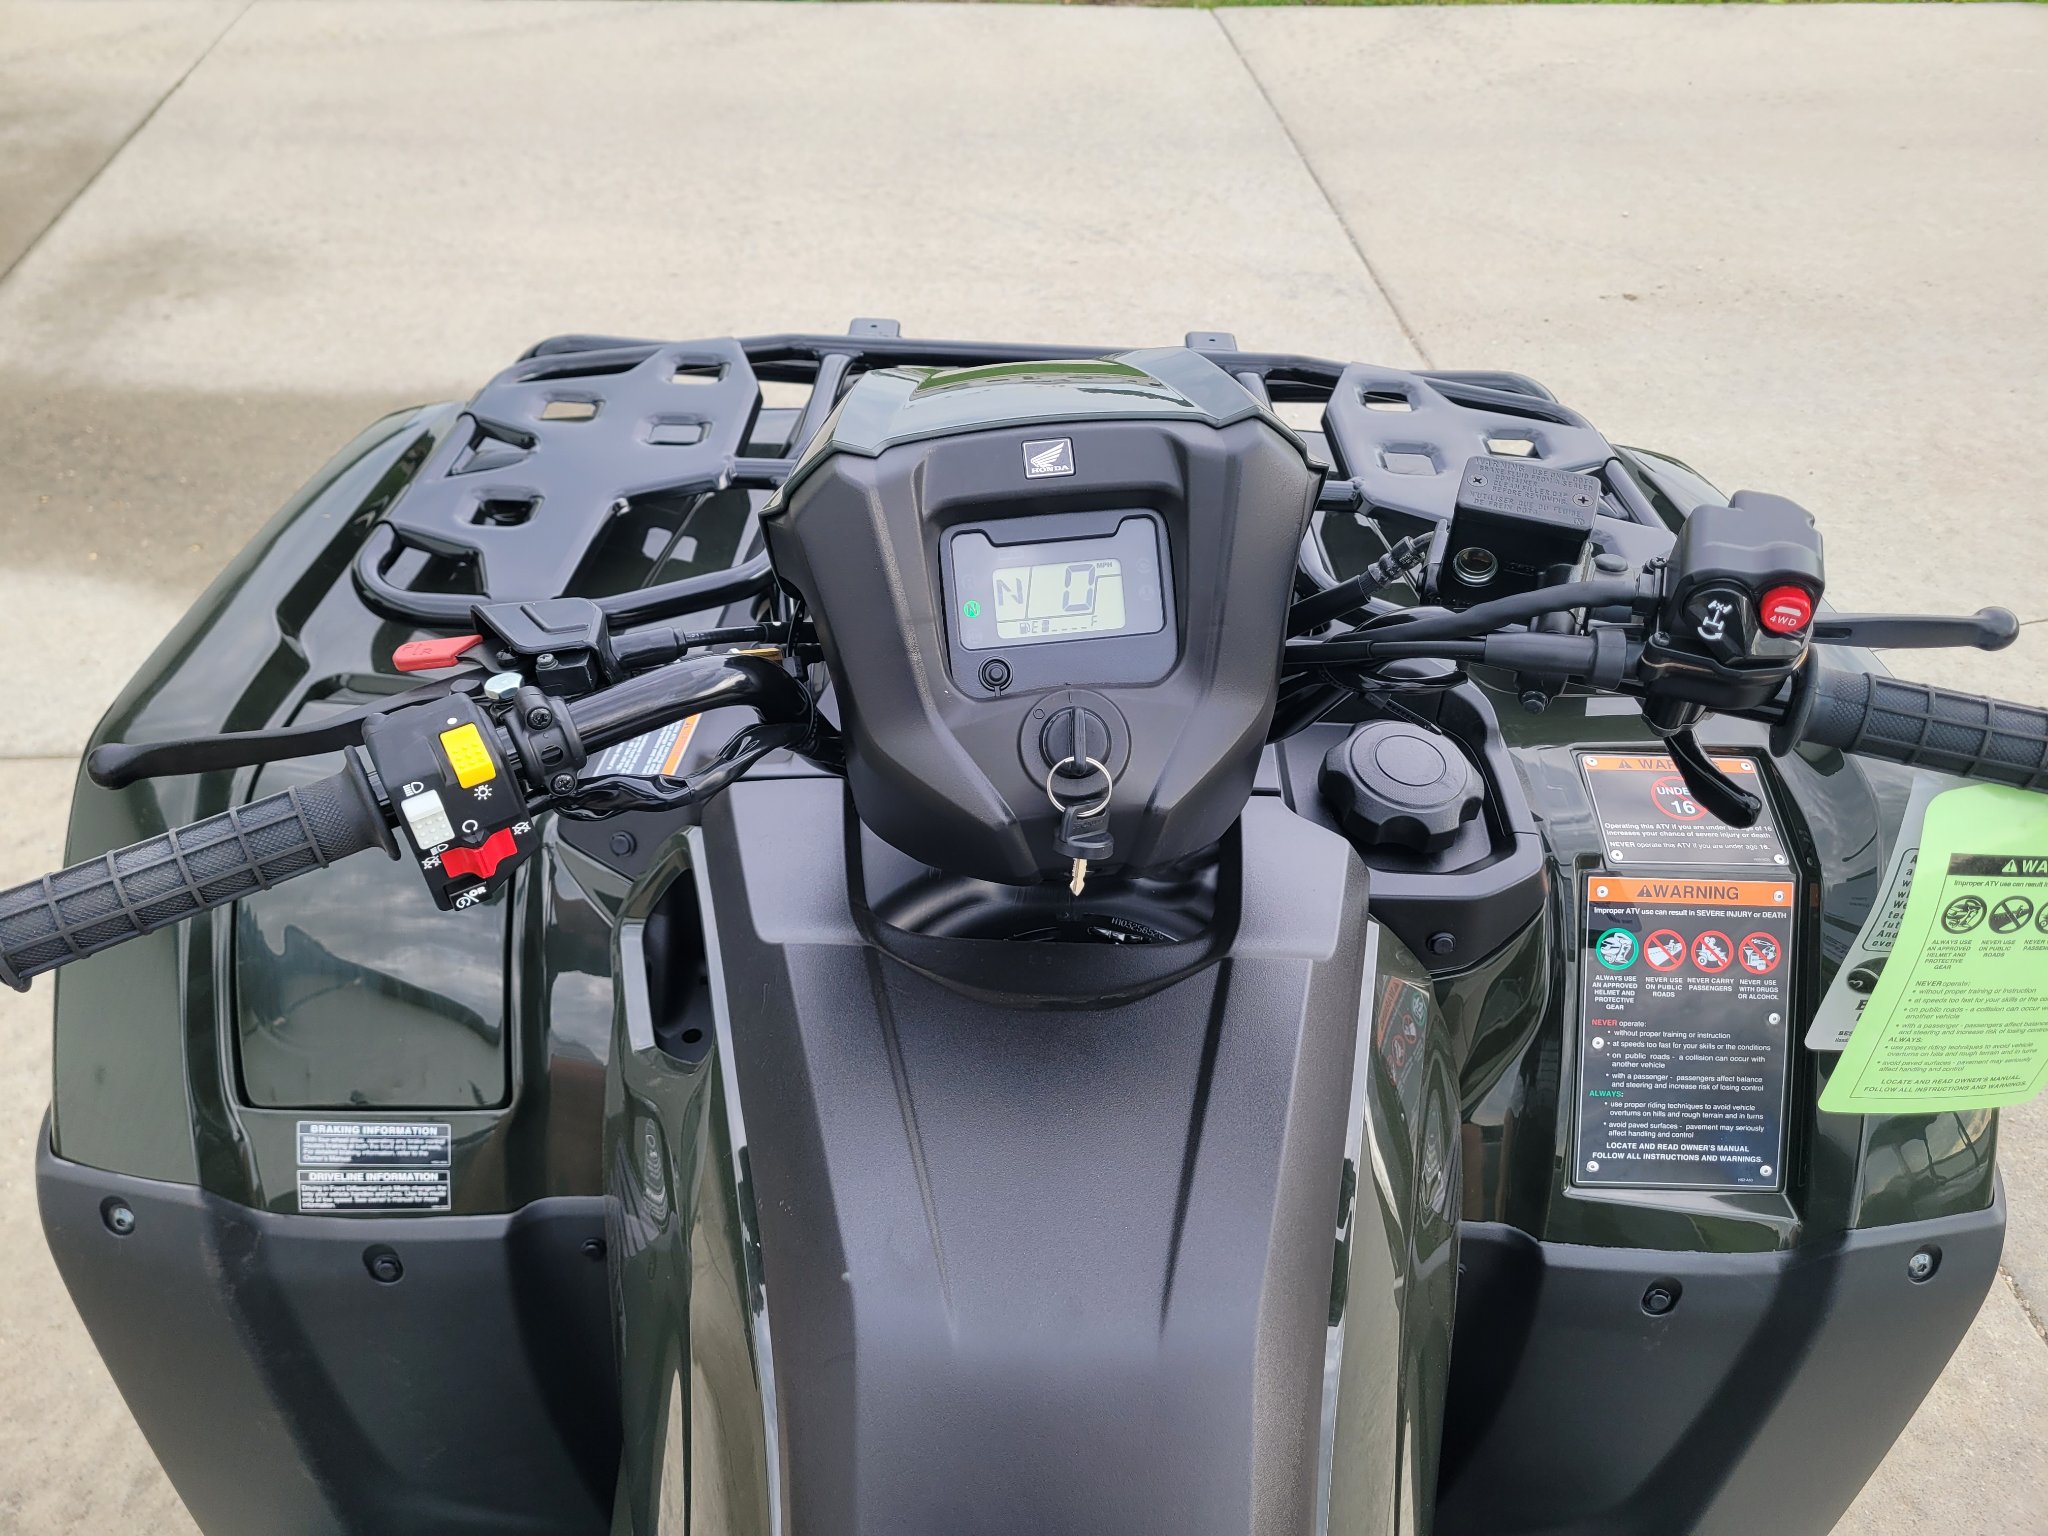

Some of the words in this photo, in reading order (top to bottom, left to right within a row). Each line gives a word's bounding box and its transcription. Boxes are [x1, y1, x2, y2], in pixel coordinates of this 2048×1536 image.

[1031, 465, 1069, 474] HONDA
[1097, 561, 1113, 569] MPH
[996, 578, 1023, 606] N
[1062, 564, 1095, 612] 0
[1769, 616, 1796, 626] 4WD
[1656, 787, 1690, 796] UNDE
[1671, 801, 1696, 814] 16
[1954, 880, 1984, 888] Improper
[469, 886, 487, 897] OR
[1653, 885, 1739, 900] WARNING
[1594, 907, 1624, 916] Improper
[1762, 911, 1786, 919] DEATH
[1662, 1031, 1687, 1040] training
[1696, 1031, 1730, 1039] instruction
[1620, 1040, 1645, 1049] speeds
[1682, 1043, 1697, 1051] your
[1737, 1043, 1770, 1051] conditions
[1624, 1052, 1646, 1061] public
[1684, 1053, 1713, 1061] collision
[1632, 1074, 1668, 1082] passenger
[1675, 1075, 1714, 1083] passengers
[1716, 1074, 1734, 1082] affect
[1623, 1102, 1645, 1110] proper
[1647, 1101, 1666, 1110] riding
[1667, 1101, 1703, 1111] techniques
[1712, 1102, 1731, 1110] avoid
[310, 1124, 360, 1134] BRAKING
[362, 1126, 437, 1135] INFORMATION
[1627, 1121, 1648, 1130] paved
[1685, 1123, 1718, 1132] pavement
[1735, 1124, 1764, 1133] seriously
[1609, 1129, 1626, 1137] affect
[1628, 1130, 1656, 1139] handling
[1642, 1153, 1699, 1161] INSTRUCTIONS
[1719, 1155, 1763, 1163] WARNINGS.
[309, 1172, 364, 1181] DRIVELINE
[366, 1172, 438, 1181] INFORMATION
